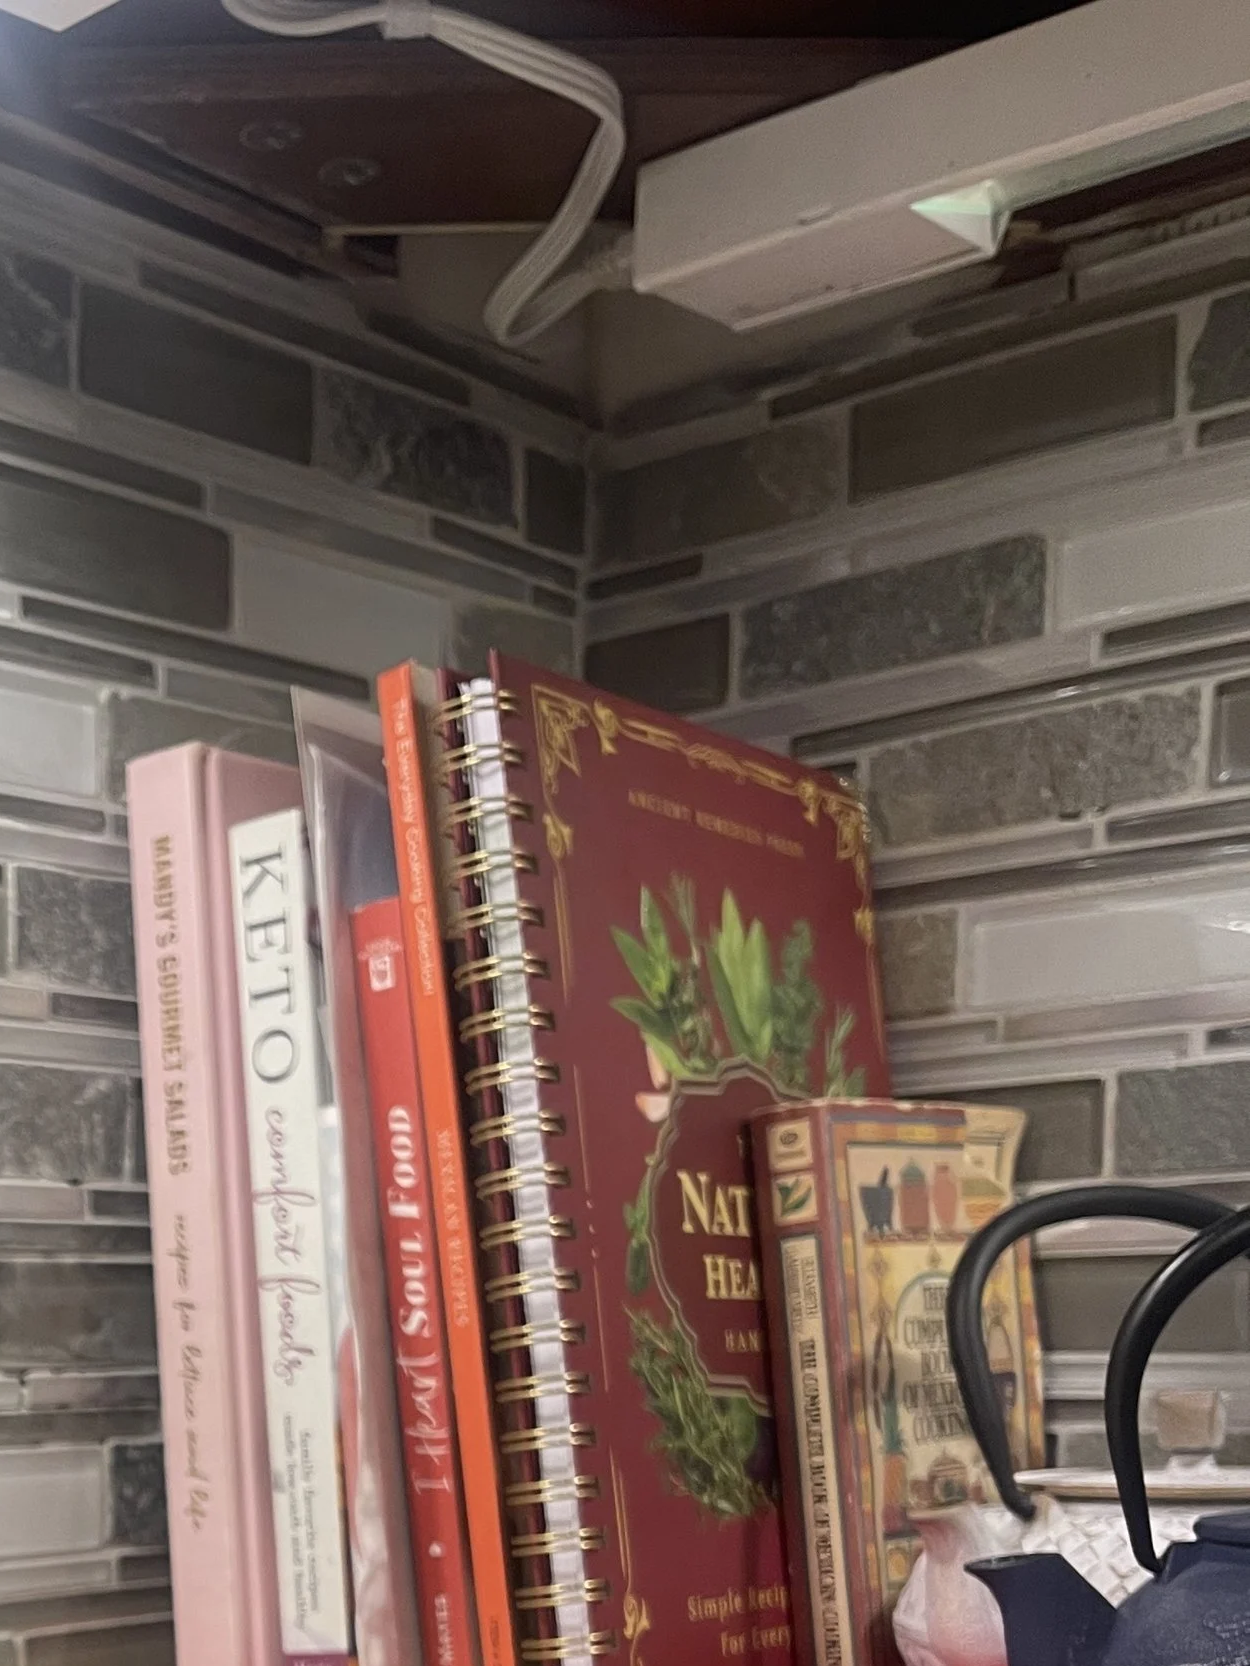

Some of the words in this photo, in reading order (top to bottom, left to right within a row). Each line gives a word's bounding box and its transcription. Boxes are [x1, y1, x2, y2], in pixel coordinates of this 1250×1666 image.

[392, 699, 408, 735] The
[396, 738, 416, 823] Everyday
[152, 835, 179, 948] MANDY'S
[405, 825, 425, 903] Cooking
[238, 842, 300, 1084] KETO
[414, 904, 435, 996] Collection
[156, 954, 184, 1072] GOURMET
[163, 1081, 189, 1176] SALADS
[252, 1105, 317, 1267] comfort
[676, 1168, 752, 1238] NAT
[703, 1254, 760, 1301] HEA
[257, 1273, 323, 1386] foods
[724, 1329, 761, 1352] HAN
[687, 1587, 743, 1622] Simple
[748, 1582, 788, 1613] Recip
[752, 1625, 791, 1650] Every
